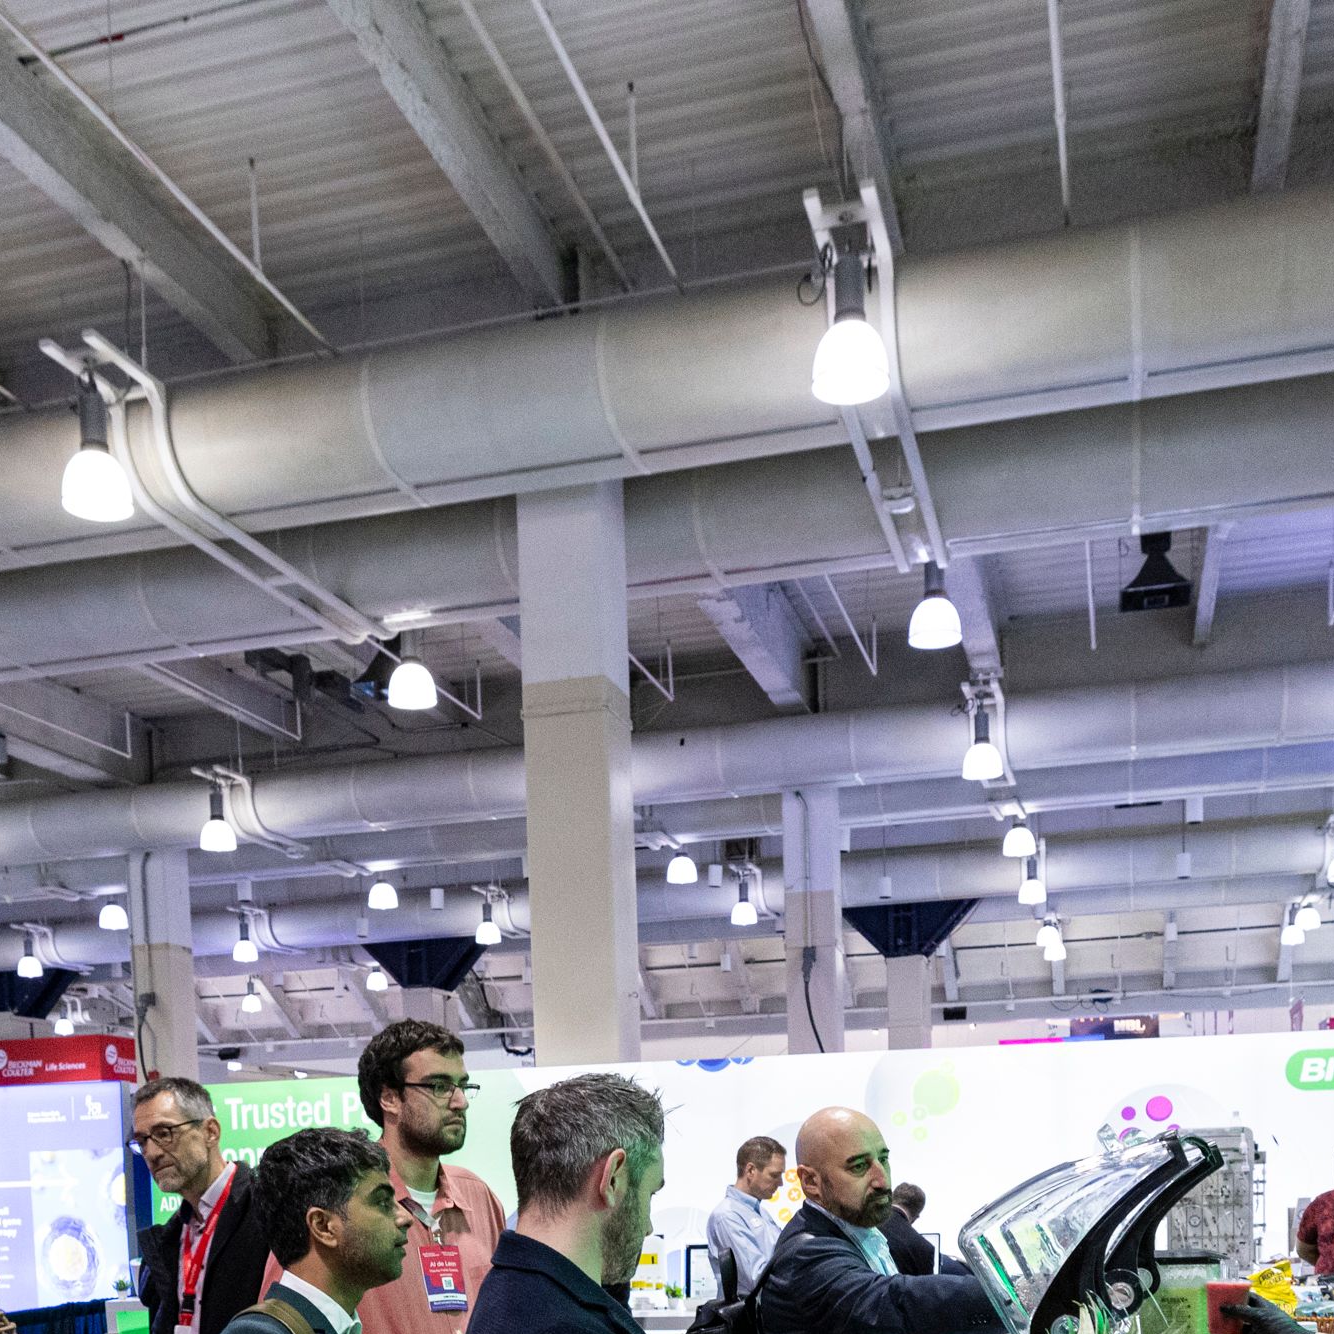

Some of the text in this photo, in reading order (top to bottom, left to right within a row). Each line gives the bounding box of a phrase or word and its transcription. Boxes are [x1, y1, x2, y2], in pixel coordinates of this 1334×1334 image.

[44, 1062, 57, 1071] Life
[58, 1062, 86, 1071] Sciences
[1, 1068, 34, 1077] COULTER
[224, 1092, 331, 1131] Trusted
